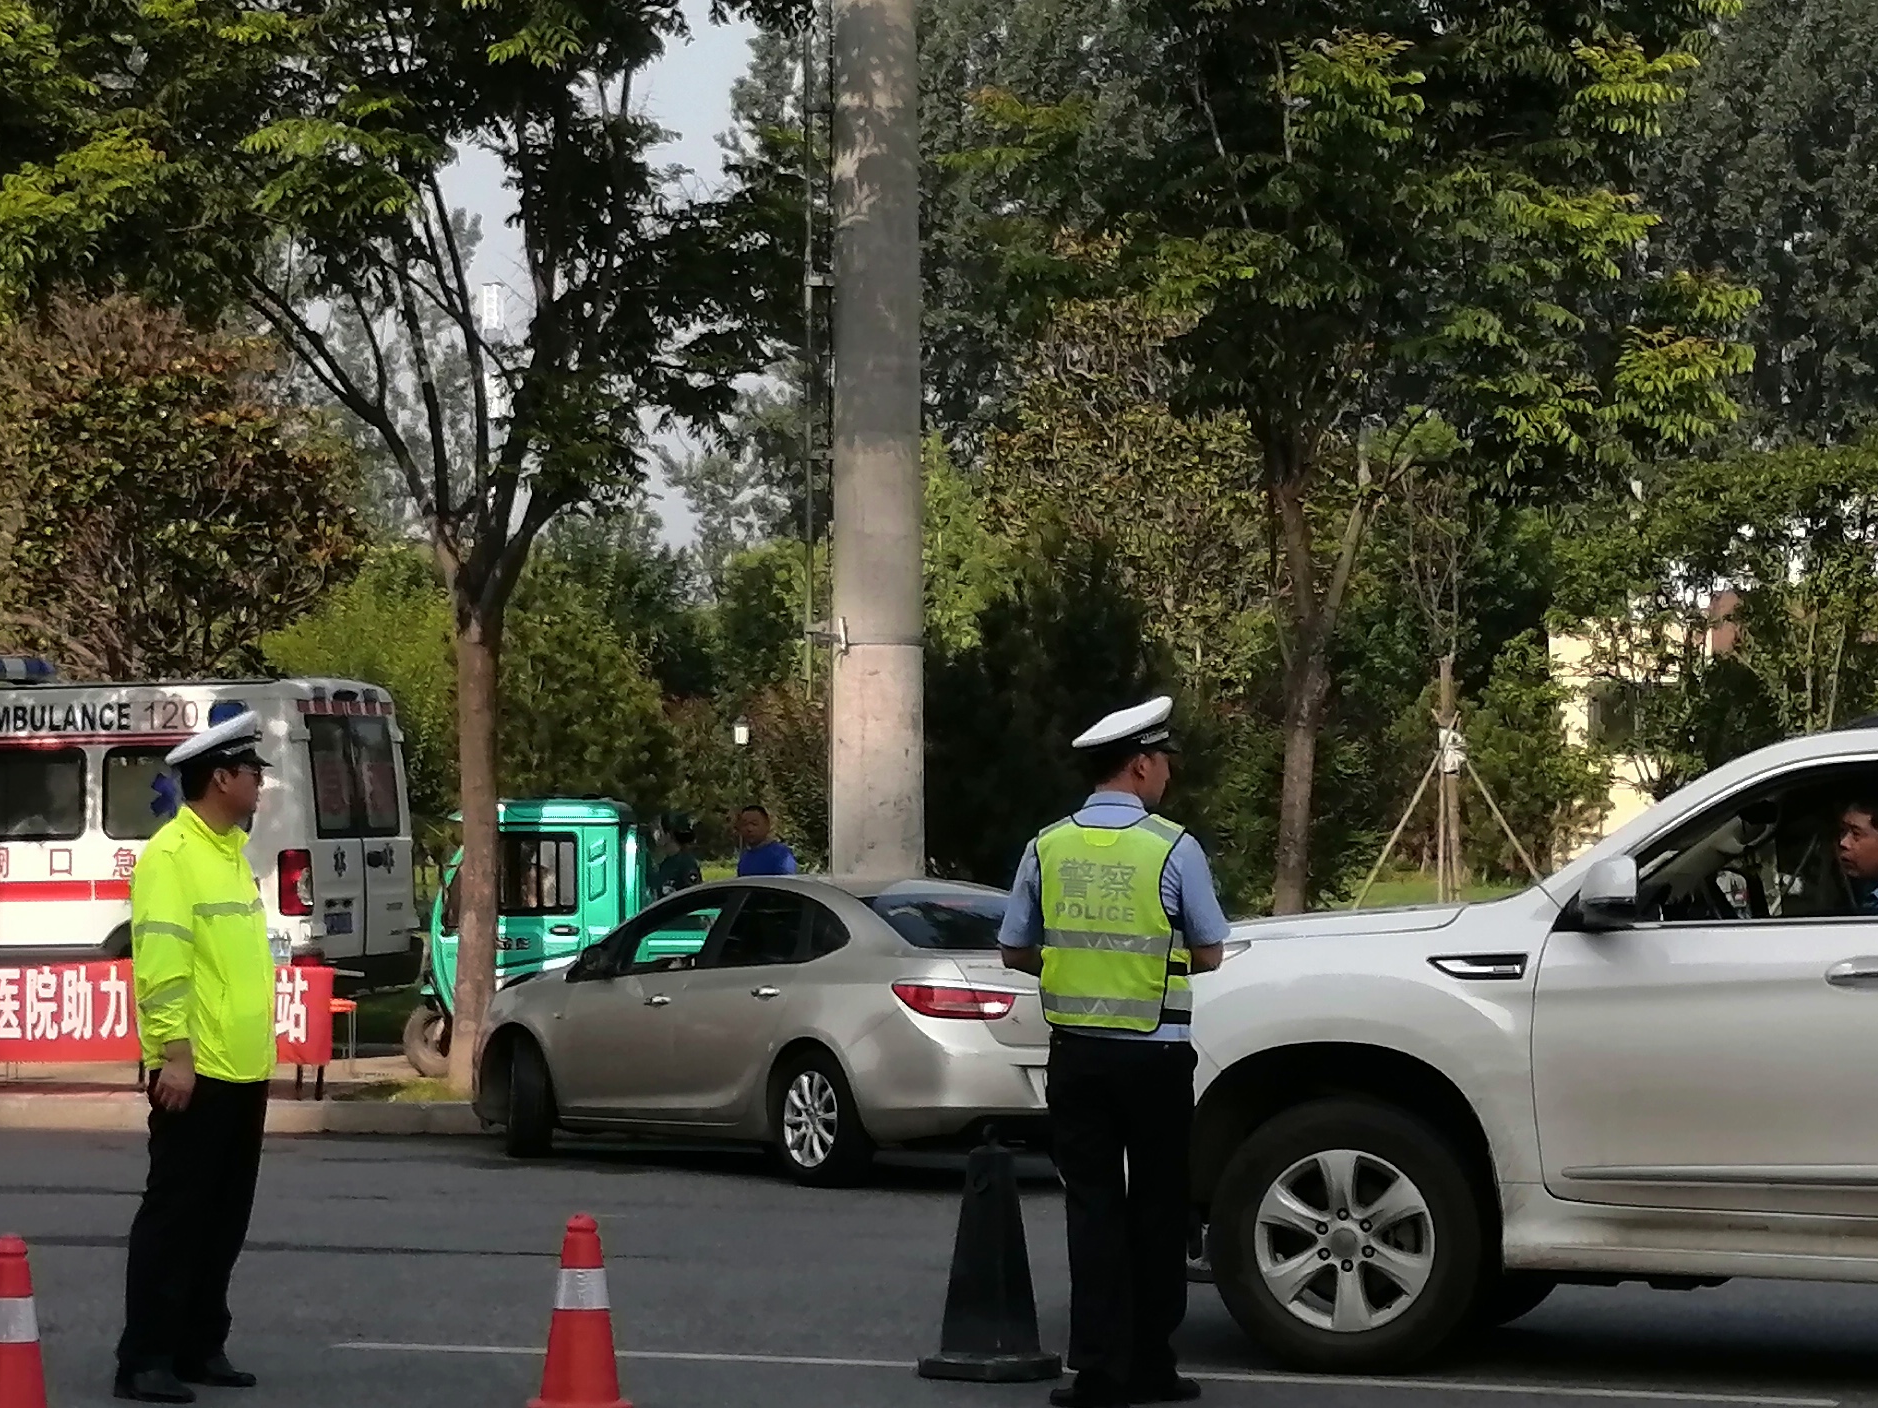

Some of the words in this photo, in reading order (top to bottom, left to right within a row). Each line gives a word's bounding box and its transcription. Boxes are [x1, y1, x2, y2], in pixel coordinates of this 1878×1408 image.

[143, 699, 200, 731] 120
[1059, 858, 1137, 901] 警察
[1056, 902, 1135, 923] POLICE
